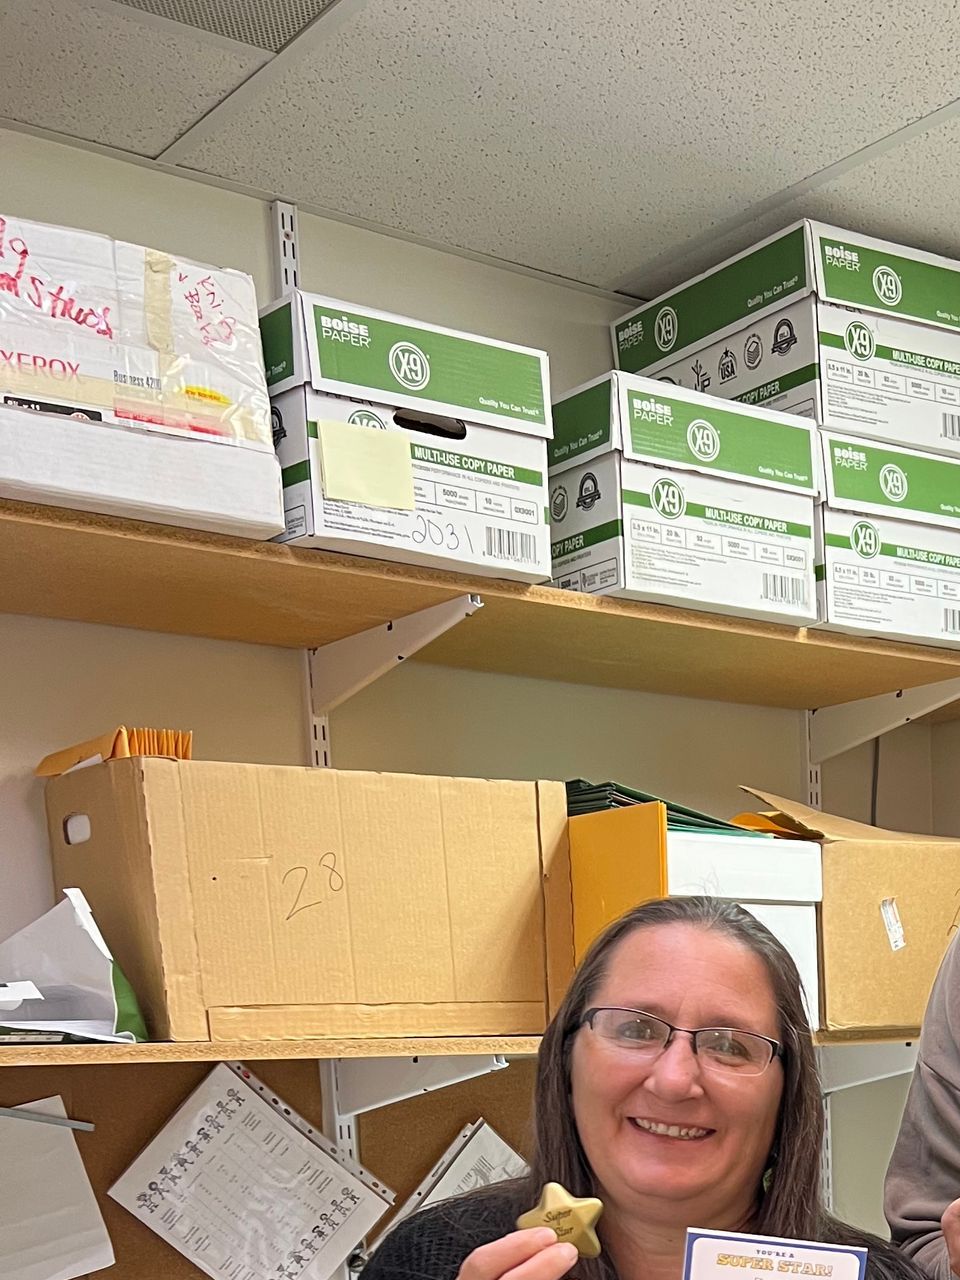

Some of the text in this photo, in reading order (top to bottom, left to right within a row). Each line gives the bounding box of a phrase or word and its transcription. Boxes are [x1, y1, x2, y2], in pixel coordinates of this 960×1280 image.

[824, 245, 858, 262] BOISE
[825, 254, 859, 272] PAPER
[320, 315, 368, 336] BOISE
[321, 327, 369, 348] PAPER
[892, 349, 925, 366] MULTI-USE
[925, 357, 943, 370] COPY
[720, 364, 736, 380] USA
[632, 398, 671, 415] BOISE
[633, 408, 672, 426] PAPER
[414, 445, 460, 466] MULTI-USE
[461, 456, 485, 472] COPY
[486, 461, 514, 478] PAPER
[833, 446, 866, 461] BOISE
[834, 455, 866, 471] PAPER
[442, 488, 458, 500] 5000
[705, 507, 787, 532] MULTI-USE COPY PAPER
[411, 515, 474, 555] 2031
[564, 534, 584, 552] PAPER
[281, 852, 344, 921] 28
[756, 1249, 786, 1257] YOU'RE
[716, 1253, 833, 1278] SUPER STAR!
